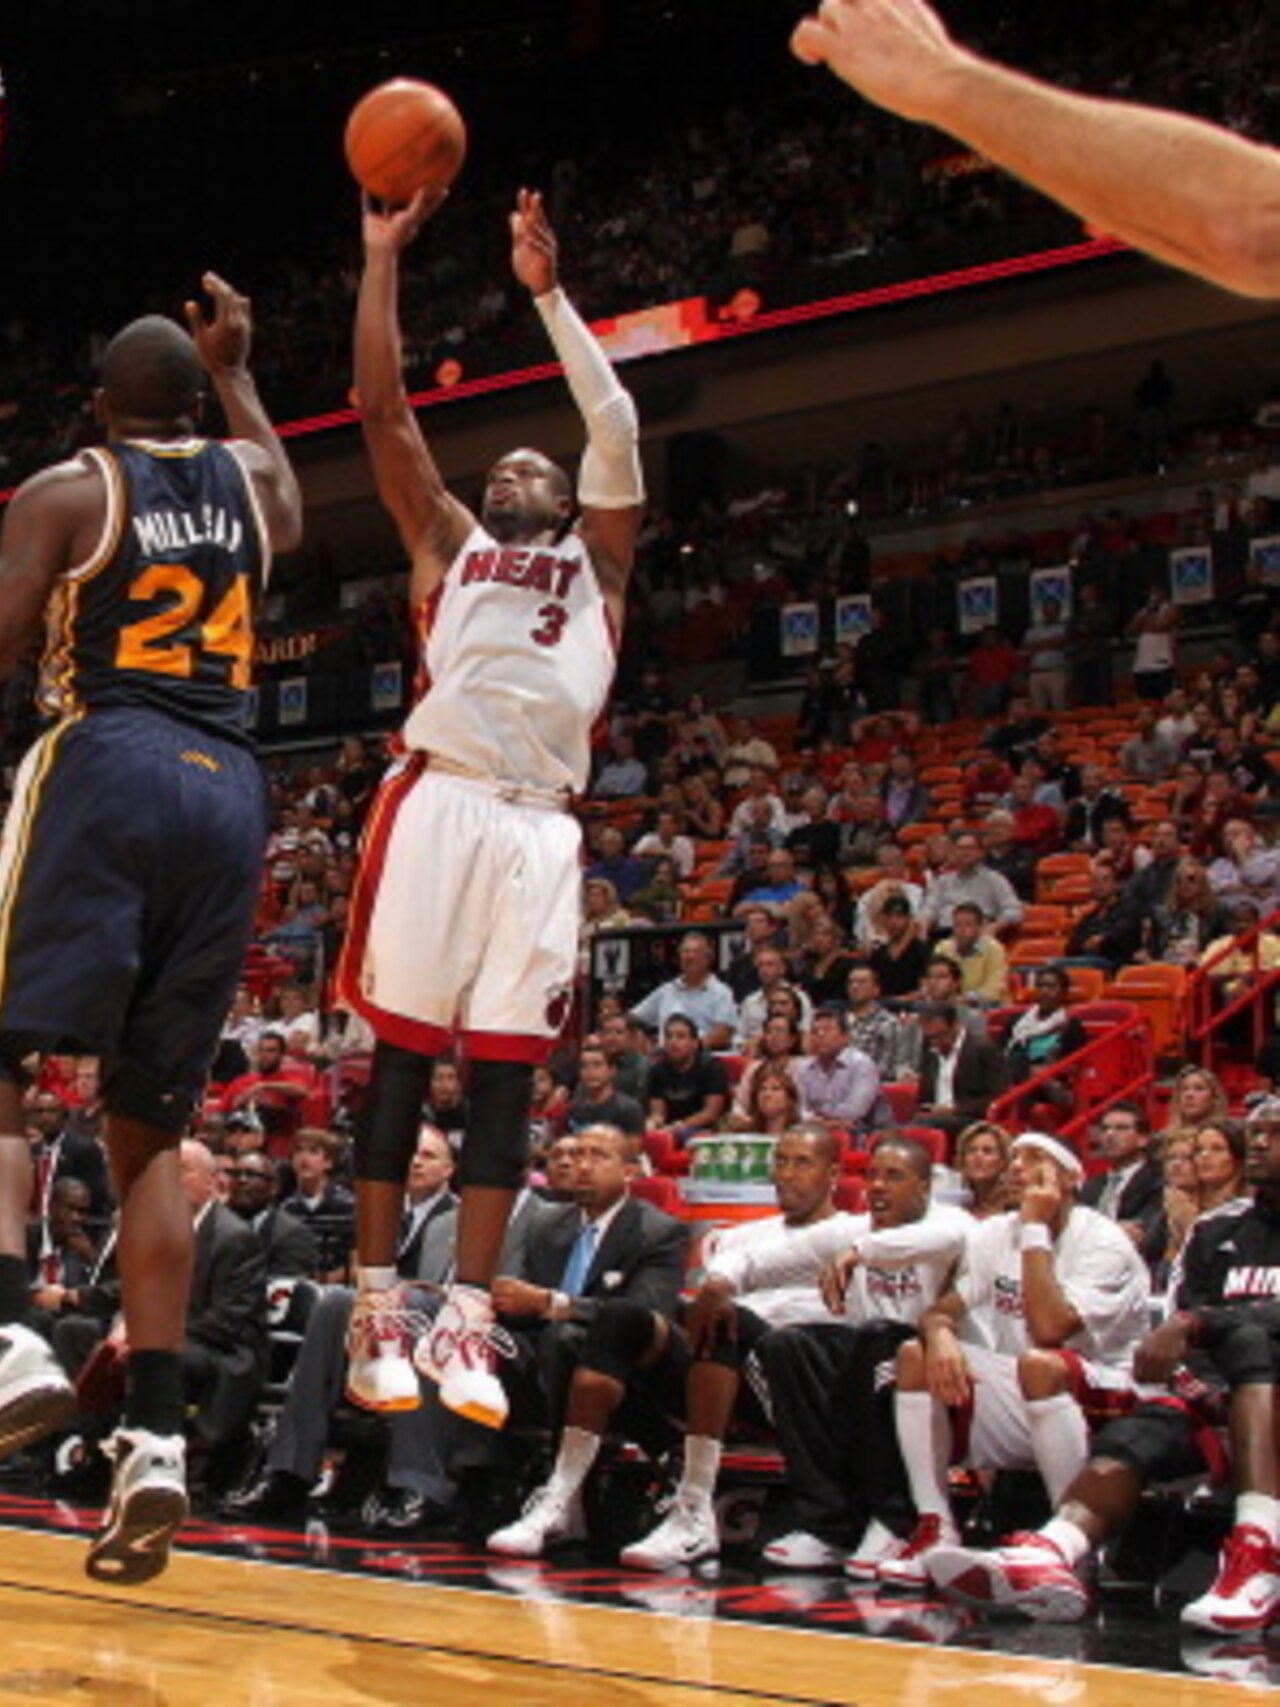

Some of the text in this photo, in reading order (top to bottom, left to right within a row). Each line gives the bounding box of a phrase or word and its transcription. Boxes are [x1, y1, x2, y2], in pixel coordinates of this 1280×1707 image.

[461, 550, 581, 599] HEAT
[116, 564, 254, 689] 24
[531, 603, 568, 647] 3
